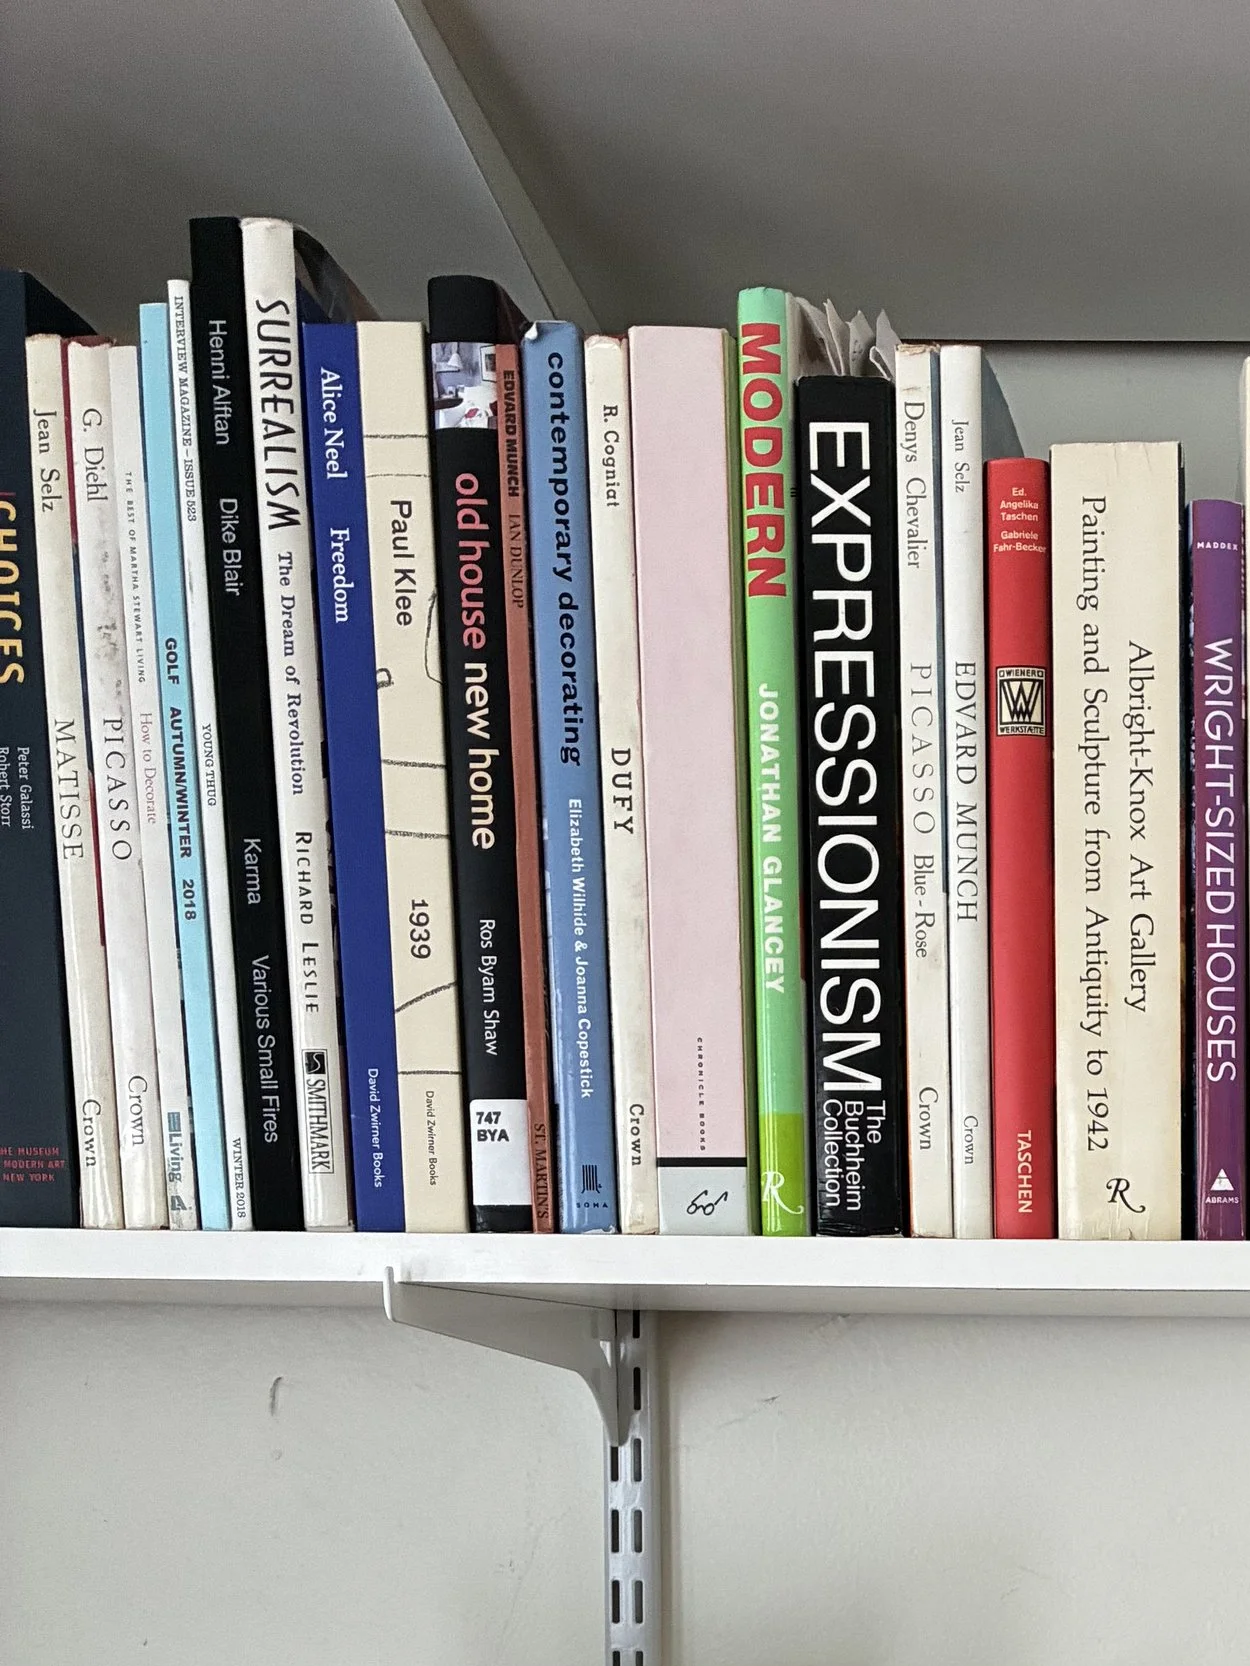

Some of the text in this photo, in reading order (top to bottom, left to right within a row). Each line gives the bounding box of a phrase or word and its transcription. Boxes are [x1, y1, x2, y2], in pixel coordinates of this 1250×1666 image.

[174, 296, 197, 522] INTERVIEW MAGAZINE ISSUE 523
[209, 320, 234, 444] Henni Alftan
[255, 299, 301, 531] SURREALISM
[320, 367, 347, 480] Alice Neel
[82, 409, 106, 502] G. Diehl
[603, 405, 620, 507] R. Cogniat
[741, 322, 786, 598] MODERN
[900, 402, 928, 568] Denys Chevalier
[1000, 500, 1038, 510] Angelika
[1000, 512, 1038, 521] Taschen
[218, 498, 242, 596] Dike Blair
[330, 528, 353, 623] Freedom
[390, 500, 416, 626] Paul Klee
[546, 352, 583, 767] contemporary decorating
[993, 542, 1046, 553] Fahr-Becker
[1000, 530, 1038, 540] Gabriele
[1197, 542, 1238, 550] MADDEX
[165, 638, 180, 684] GOLF
[278, 552, 306, 795] The Dream of Revolution
[454, 473, 500, 850] old house new home
[54, 719, 83, 860] MATISSE
[103, 718, 132, 861] PICASSO
[140, 713, 159, 824] How to Decorate
[170, 707, 193, 858] AUTUMN/WINTER
[612, 748, 633, 834] DUFY
[808, 421, 882, 1091] EXPRESSIONISM
[910, 664, 935, 834] PICASSO
[954, 662, 978, 922] EDVARD MUNCH
[759, 683, 784, 994] JONATHAN GLANCEY
[1076, 496, 1111, 1152] Painting and Sculpture from Antiquity to 1942
[1123, 640, 1155, 1012] Albright-Knox Art Gallery
[1204, 638, 1236, 1082] WRIGHT-SIZED HOUSES
[411, 899, 432, 960] 1939
[479, 919, 500, 1056] Ros Byam Shaw
[568, 798, 594, 1098] Elizabeth Wilhide & Joanna Copestick
[250, 955, 280, 1142] Various Small Fires
[306, 1078, 330, 1170] SMITHMARK
[367, 1068, 384, 1188] David Zwirner Books
[476, 1112, 501, 1124] 747
[478, 1129, 509, 1142] BYA
[822, 1100, 843, 1207] Collection
[844, 1100, 864, 1211] Buchheim
[866, 1100, 886, 1144] The
[1016, 1130, 1034, 1214] TASCHEN
